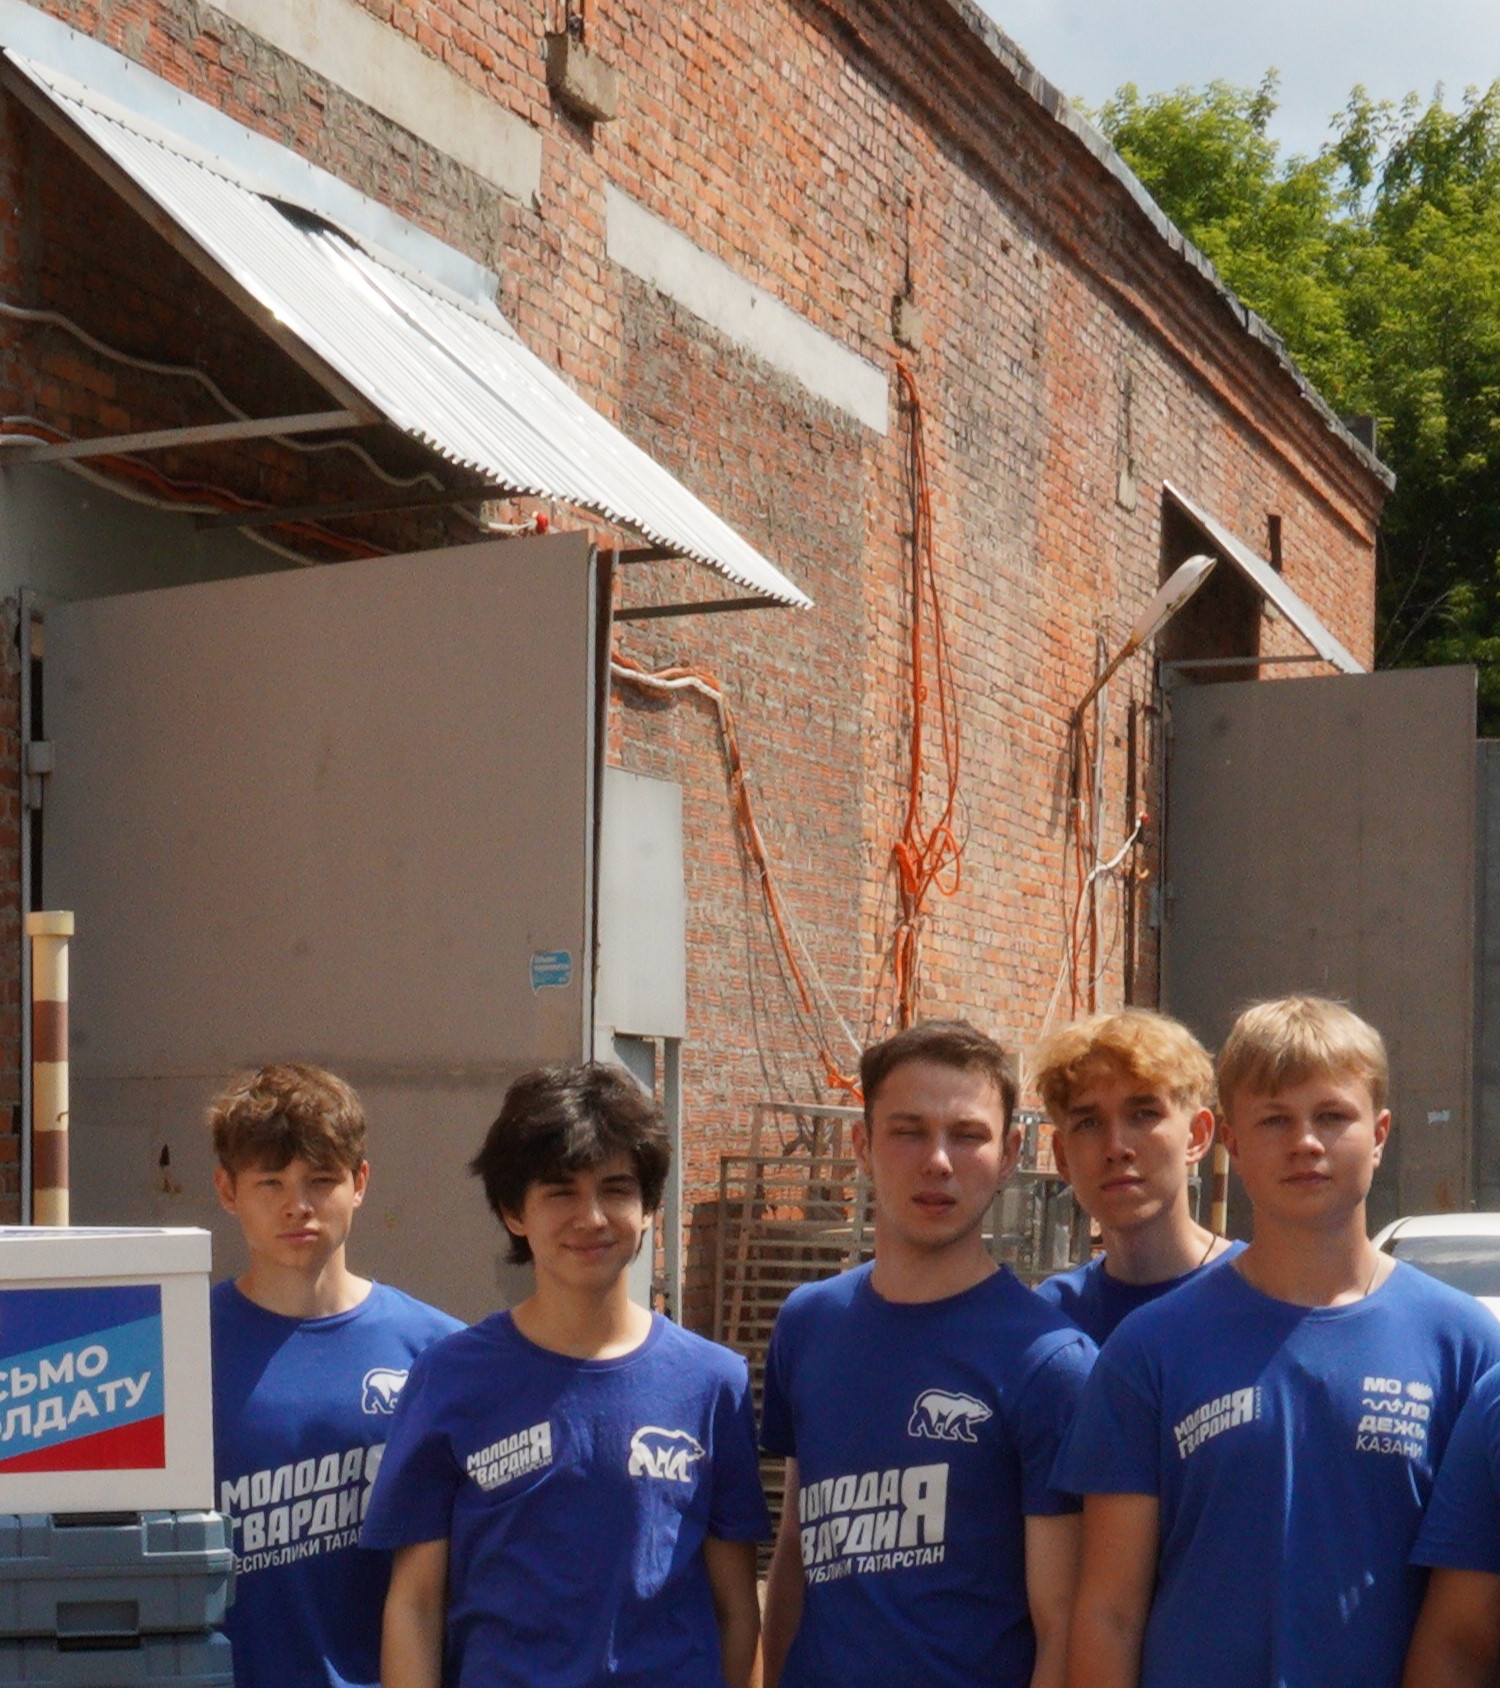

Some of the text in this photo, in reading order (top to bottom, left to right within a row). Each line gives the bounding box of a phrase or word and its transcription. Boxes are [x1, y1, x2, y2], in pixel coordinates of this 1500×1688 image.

[467, 1421, 551, 1470] МОЛОДАЯ
[235, 1539, 320, 1575] ЕСПУБЛИКИ
[801, 1510, 945, 1566] ВАРДИЯ
[857, 1545, 944, 1573] ТАТАРСТАН
